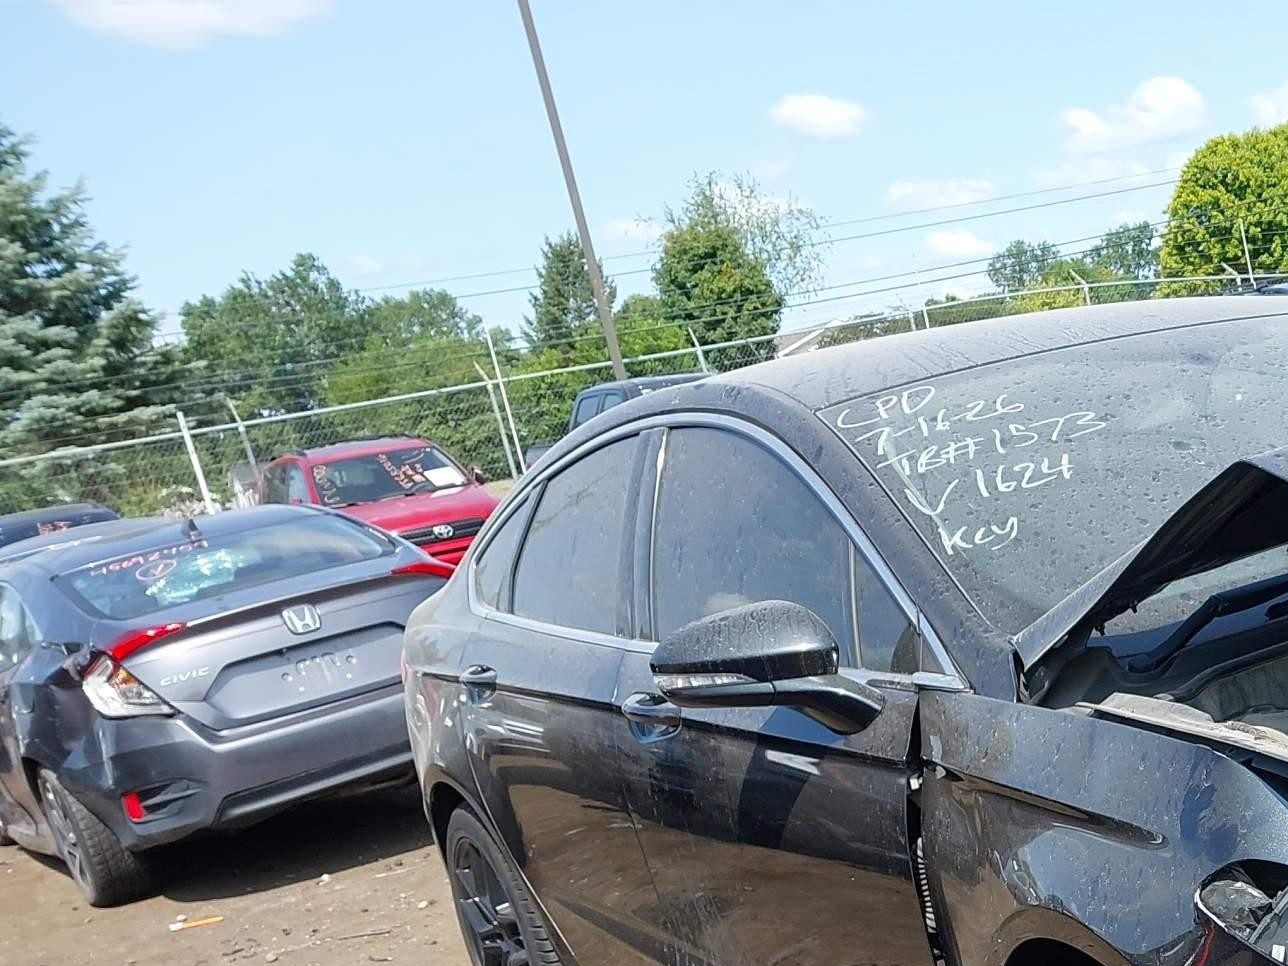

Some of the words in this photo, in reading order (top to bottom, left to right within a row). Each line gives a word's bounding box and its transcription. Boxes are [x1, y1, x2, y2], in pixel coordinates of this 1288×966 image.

[837, 385, 935, 428] CPD
[976, 453, 1074, 497] 1624
[160, 666, 209, 686] CIVIC
